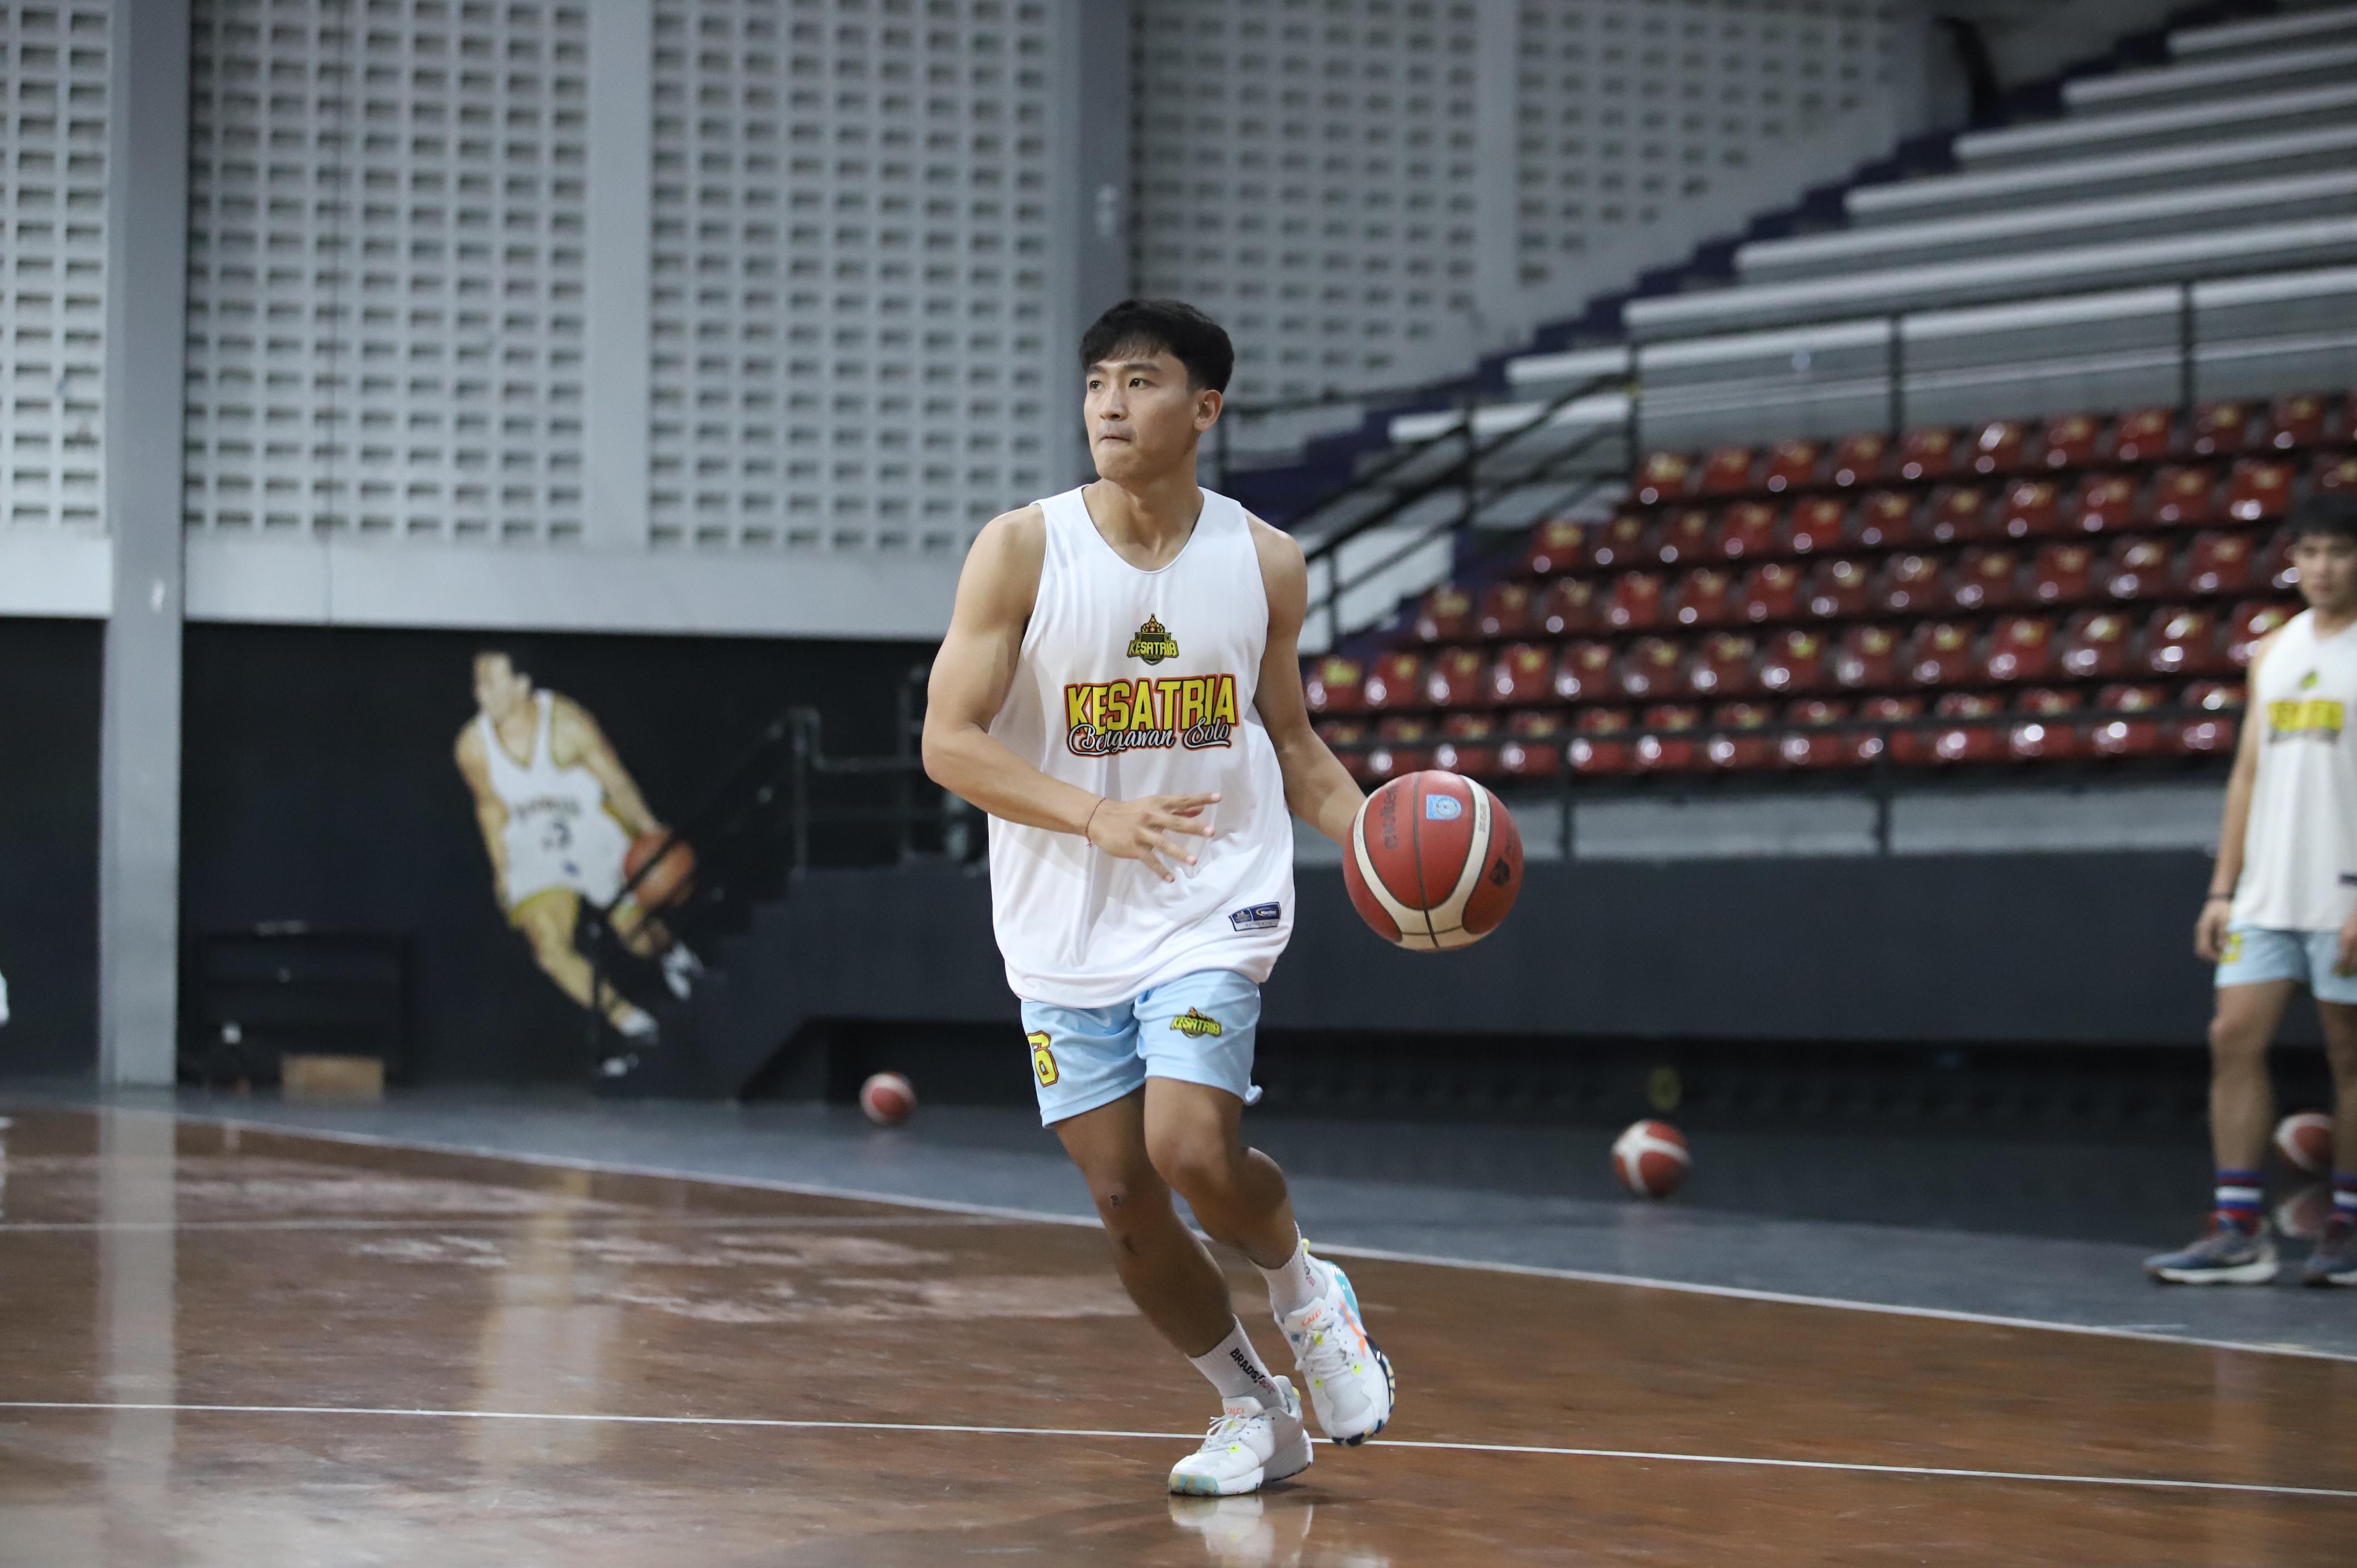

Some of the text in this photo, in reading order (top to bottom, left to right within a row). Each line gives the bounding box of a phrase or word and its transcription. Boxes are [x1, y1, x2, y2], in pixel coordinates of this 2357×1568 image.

[1129, 641, 1177, 656] KESATRIA
[1066, 675, 1237, 736] KESATRIA
[1184, 716, 1231, 749] Solo
